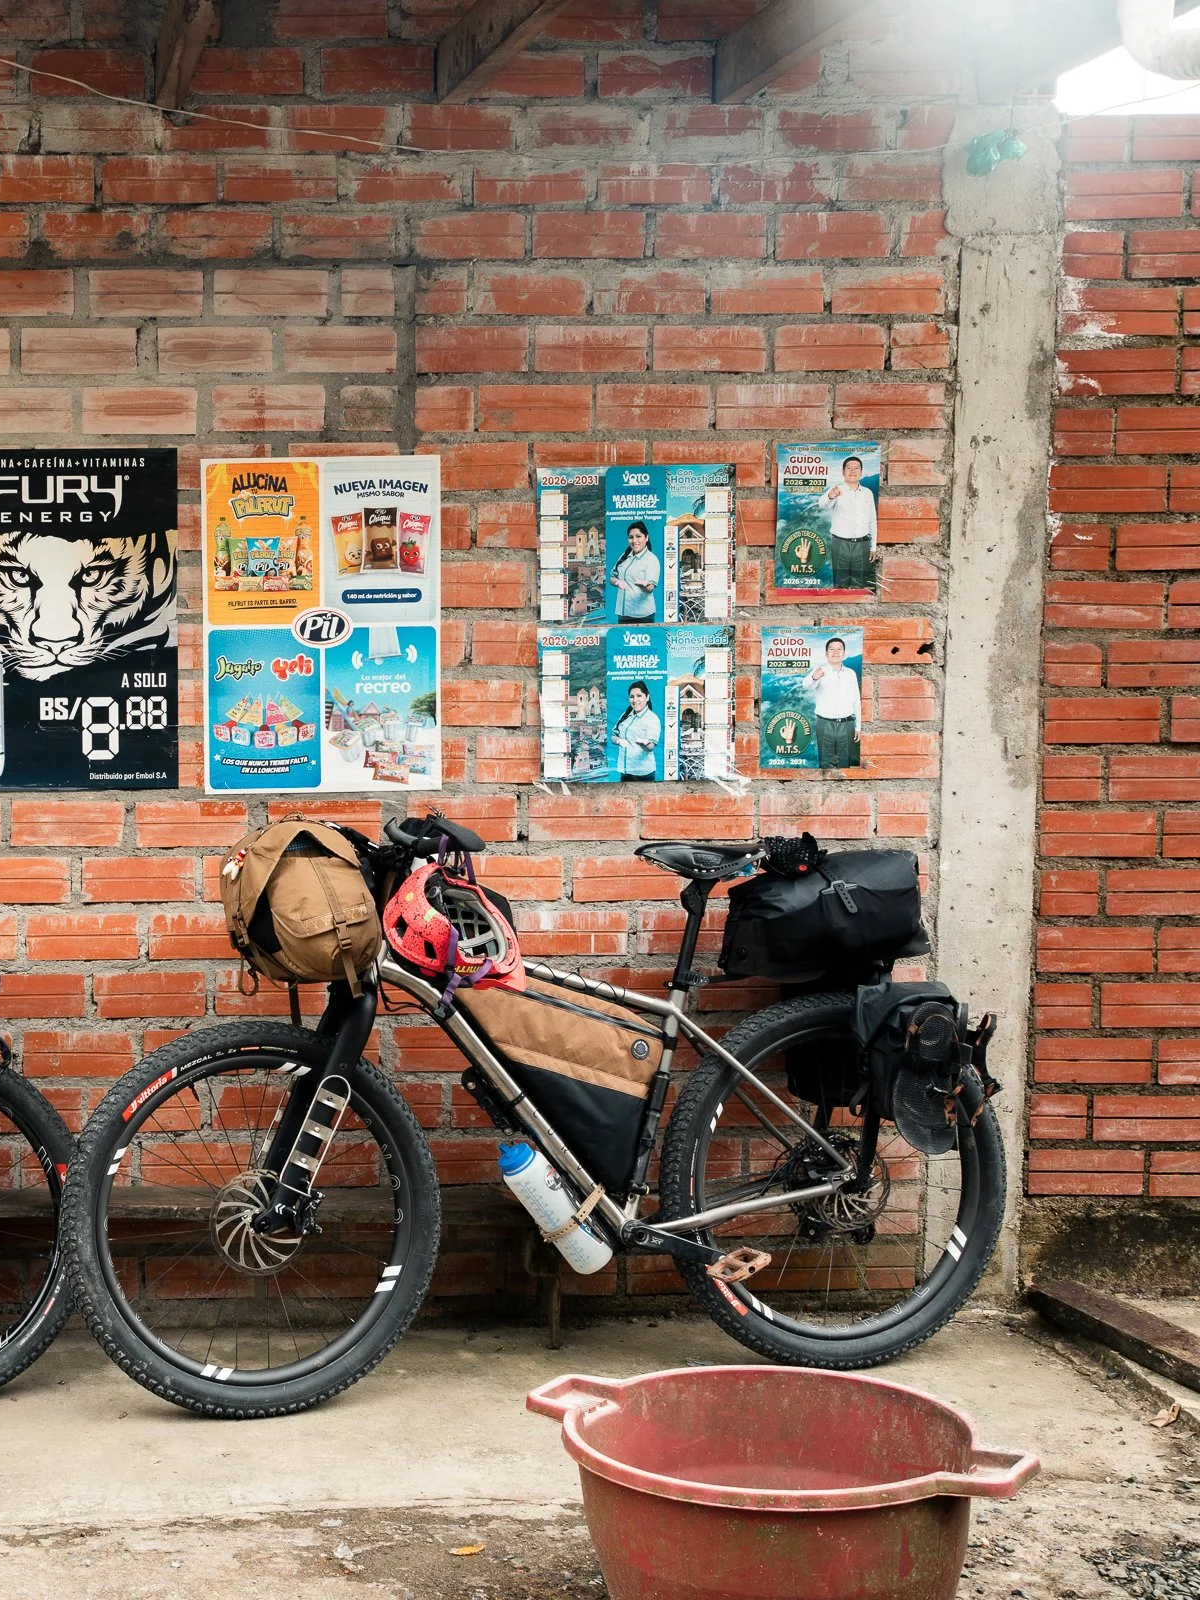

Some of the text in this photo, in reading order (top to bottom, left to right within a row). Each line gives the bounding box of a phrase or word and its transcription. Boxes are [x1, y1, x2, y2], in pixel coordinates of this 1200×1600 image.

[784, 465, 828, 476] ADUVIRI
[541, 475, 599, 486] 2026 2031
[622, 473, 651, 482] VOTO
[670, 474, 729, 484] Honestidad
[333, 479, 429, 496] NUEVA IMAGEN
[357, 490, 405, 499] MISMO SABOR
[612, 494, 660, 502] MARISCAL
[0, 511, 112, 523] ENERGY
[791, 564, 816, 573] M.T.S.
[303, 614, 338, 640] Pil
[541, 635, 600, 646] 2026 2031
[623, 634, 650, 643] VOTO
[670, 635, 729, 645] Honestidad
[767, 647, 812, 657] ADUVIRI
[613, 654, 660, 662] MARISCAL
[616, 661, 658, 669] RAMIREZ
[121, 672, 167, 688] A SOLO
[355, 682, 412, 694] recreo
[776, 745, 801, 754] M.T.S.
[89, 772, 122, 780] Distribuido
[124, 773, 134, 781] por
[136, 771, 154, 779] Embol
[180, 1054, 213, 1072] MEZCAL
[136, 1075, 168, 1103] vittoria
